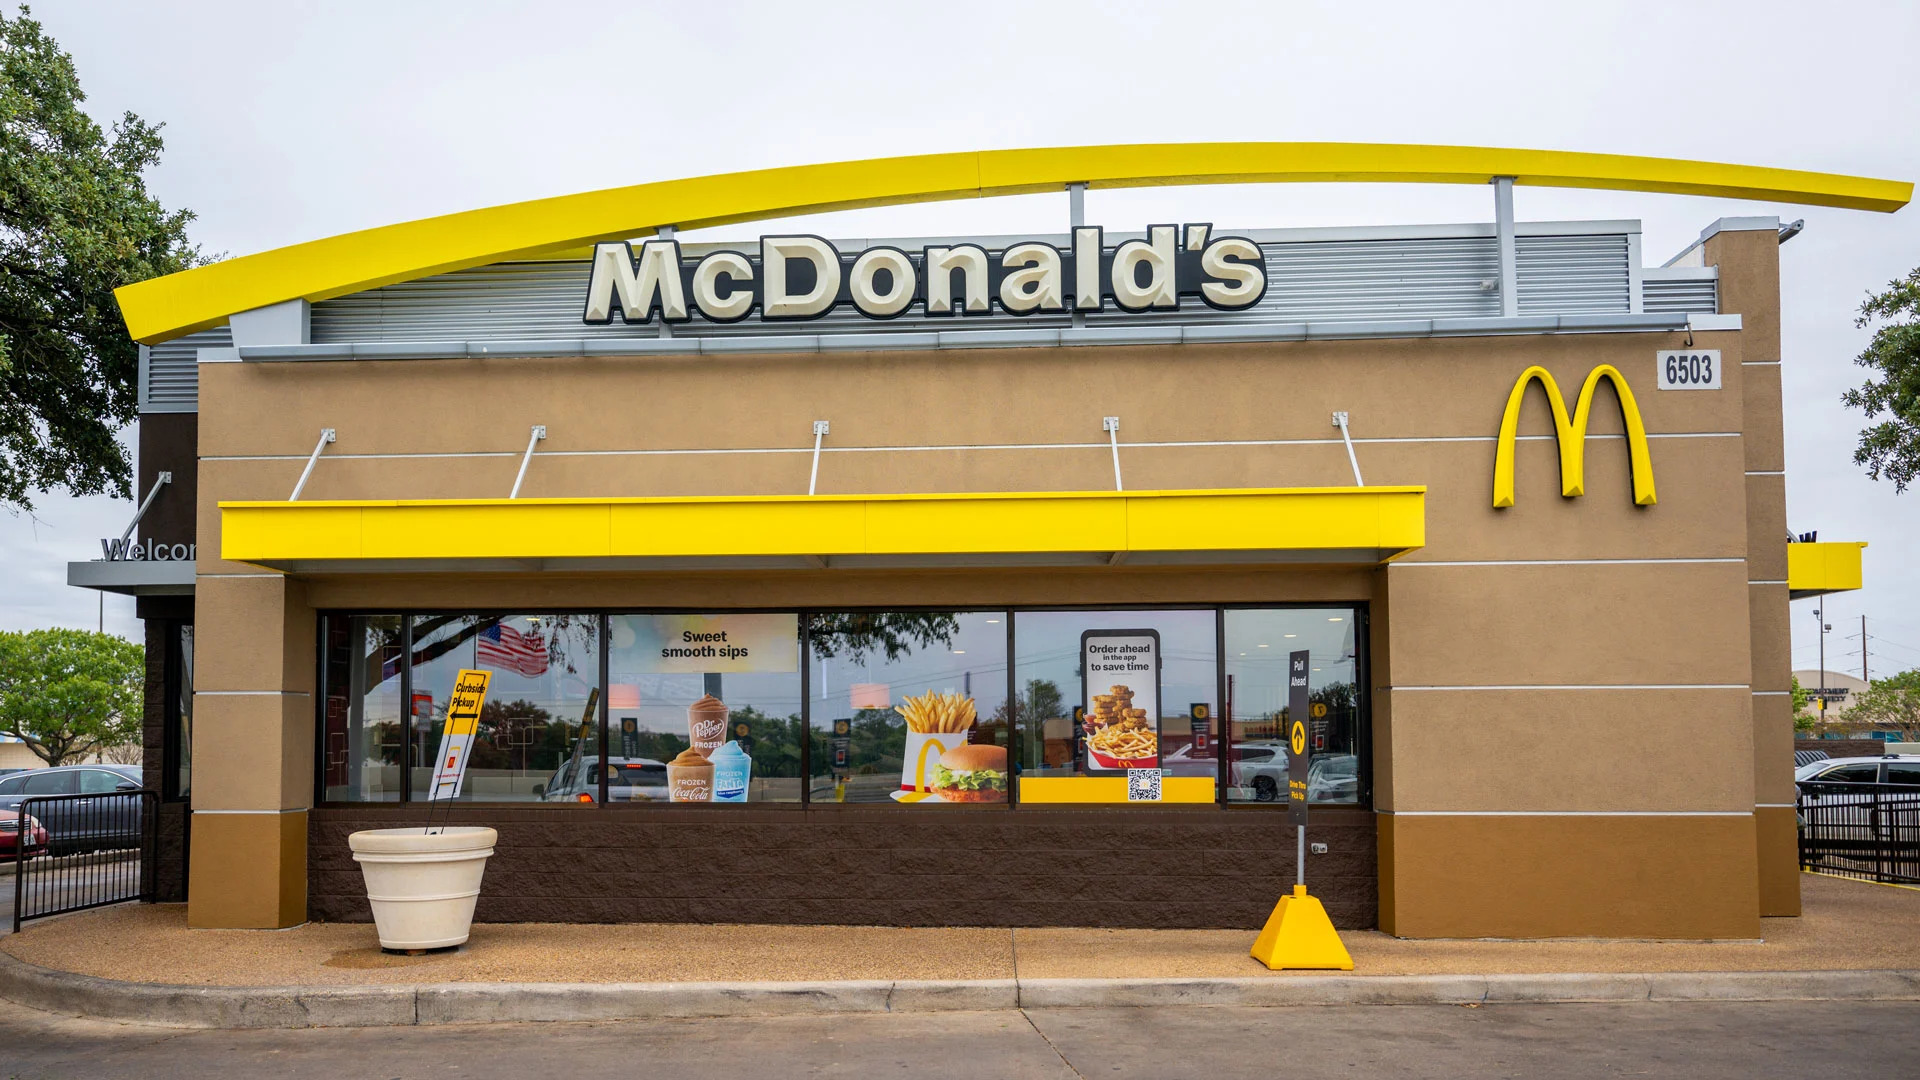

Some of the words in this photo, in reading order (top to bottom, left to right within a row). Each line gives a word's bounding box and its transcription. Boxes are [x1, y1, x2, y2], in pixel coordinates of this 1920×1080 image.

[584, 223, 1268, 324] McDonald's
[1666, 355, 1712, 384] 6503
[683, 631, 727, 642] Sweet
[662, 645, 716, 657] smooth
[719, 645, 748, 660] sips
[1089, 645, 1118, 653] Order
[1120, 644, 1150, 653] ahead
[1091, 663, 1101, 671] to
[1127, 662, 1149, 671] time
[1294, 660, 1304, 671] Pull
[1291, 676, 1307, 687] Ahead
[455, 682, 486, 694] Curbside
[452, 697, 475, 709] Pickup
[703, 719, 715, 728] Dr
[693, 722, 722, 738] Pepper
